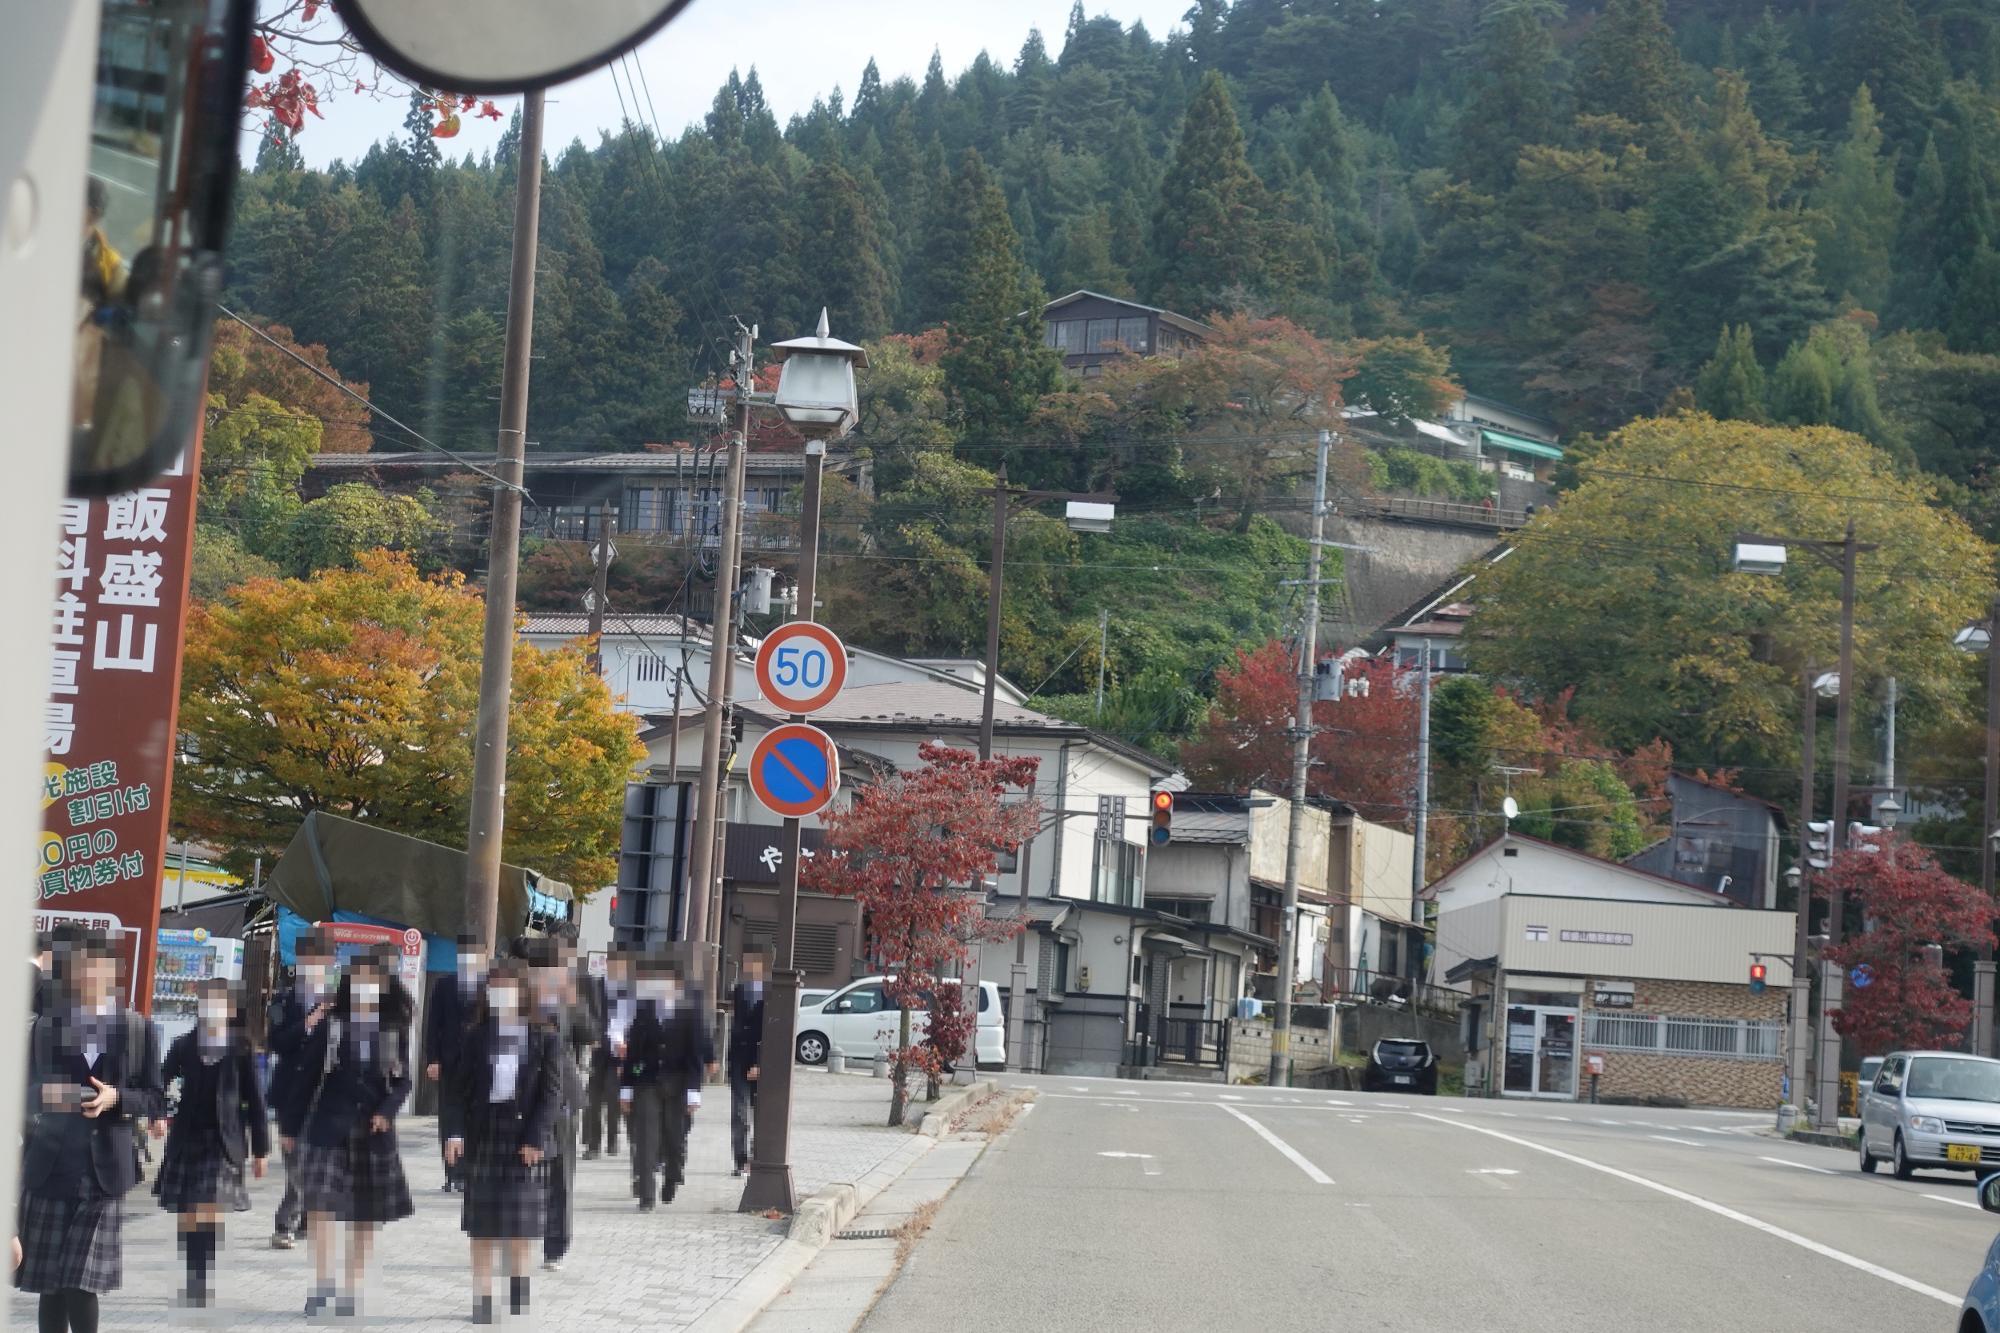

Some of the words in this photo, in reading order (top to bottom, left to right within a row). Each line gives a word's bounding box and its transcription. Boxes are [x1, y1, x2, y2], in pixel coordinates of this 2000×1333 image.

[93, 488, 171, 673] 飯盛山
[775, 647, 826, 689] 50
[67, 783, 150, 826] 割引付
[36, 828, 118, 867] 0円の
